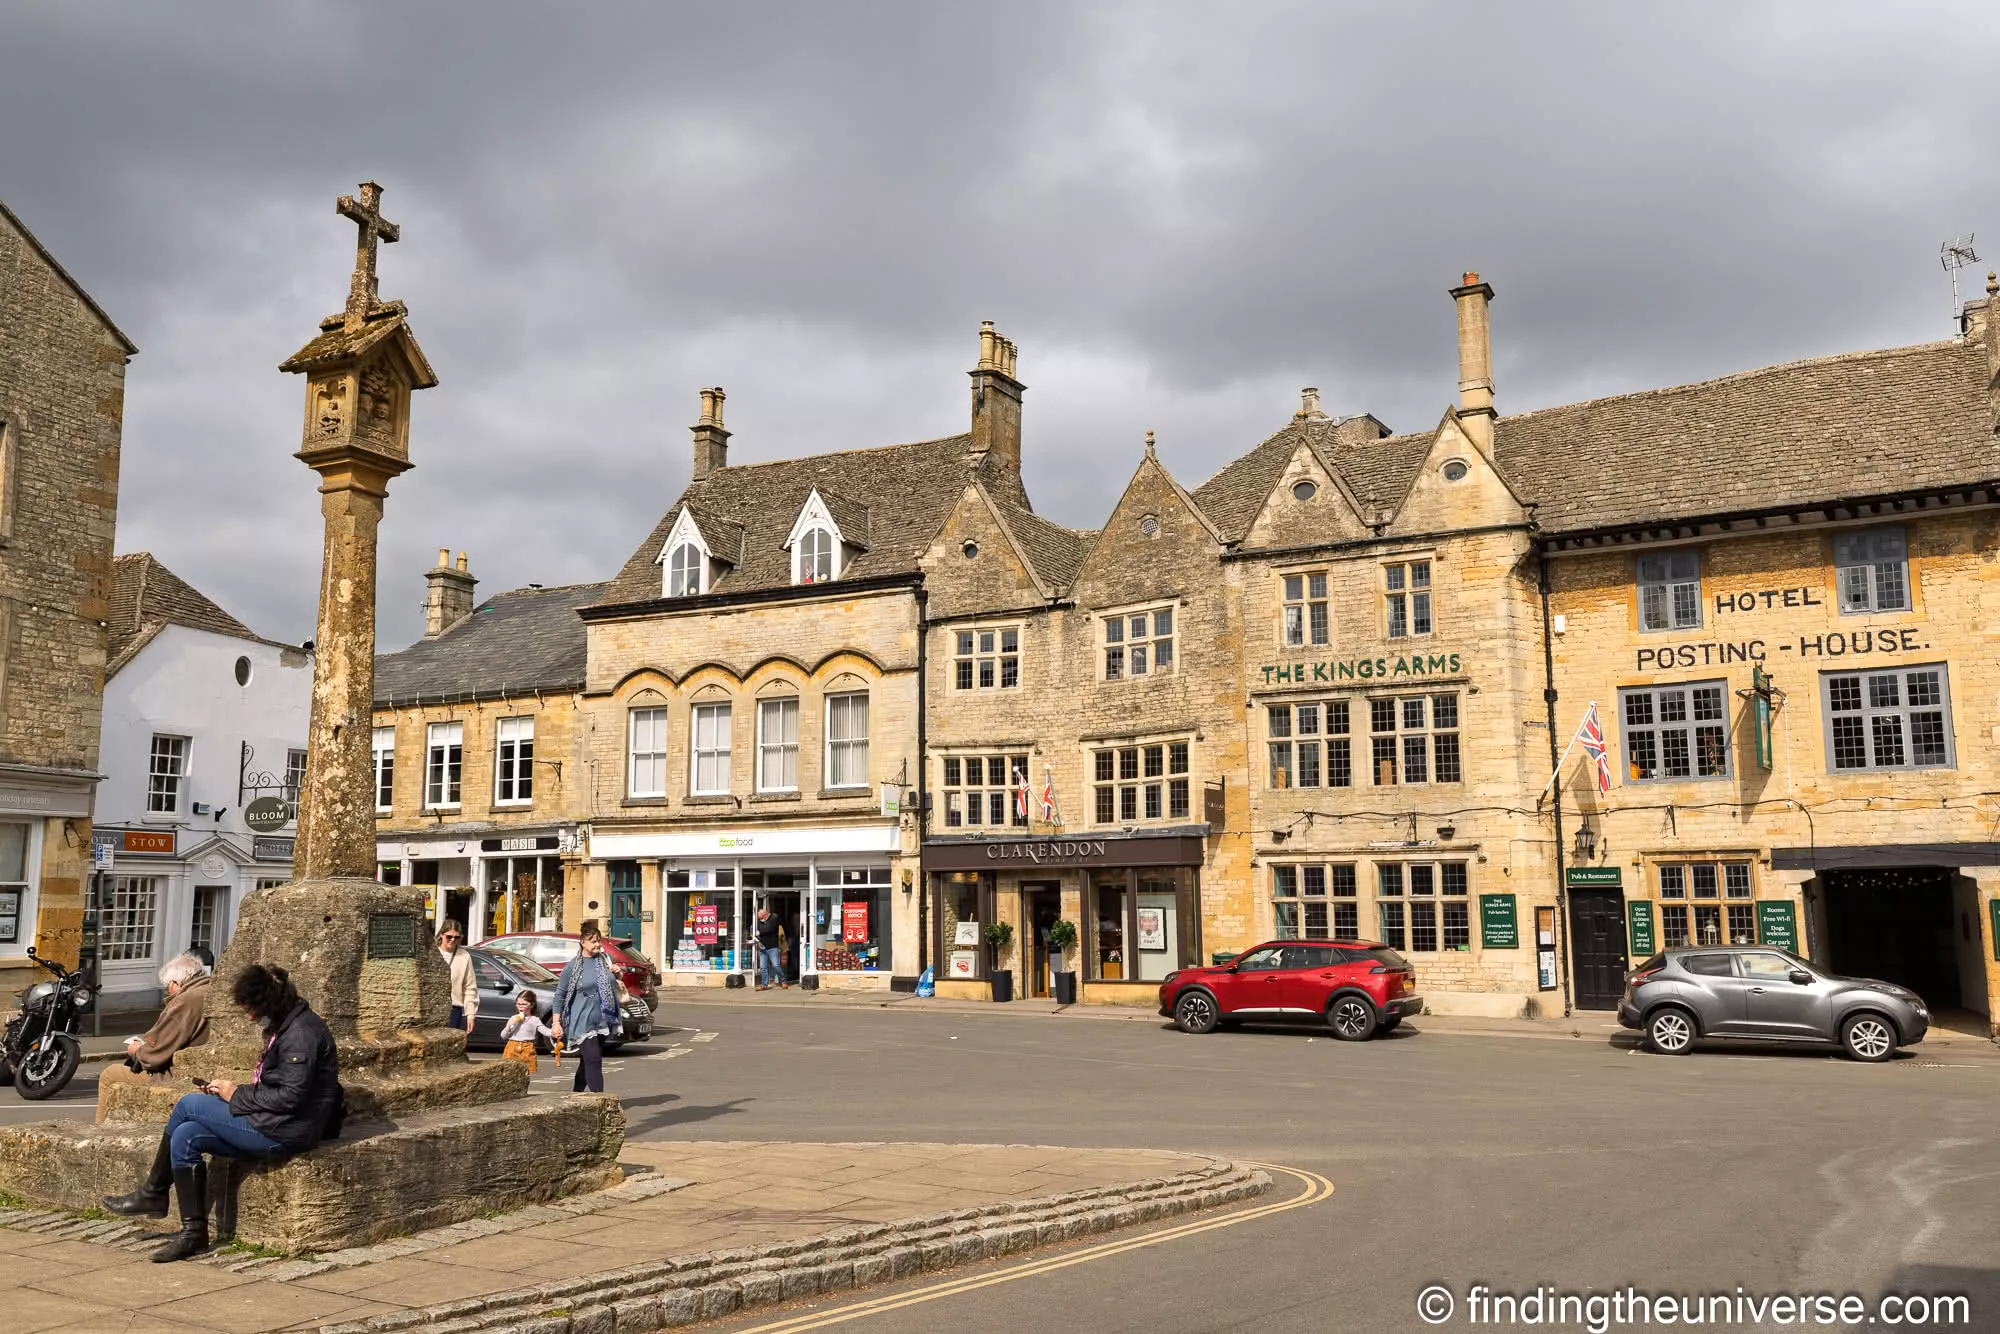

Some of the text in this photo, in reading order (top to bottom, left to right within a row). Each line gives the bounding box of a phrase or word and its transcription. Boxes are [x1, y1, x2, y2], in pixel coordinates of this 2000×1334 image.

[1715, 587, 1822, 614] HOTEL
[1637, 640, 1766, 671] POSTING
[1261, 653, 1461, 684] THE KINGS ARMS
[249, 811, 285, 821] BLOOM
[131, 837, 167, 847] STOW
[502, 839, 536, 850] MASH
[736, 837, 753, 847] food
[987, 841, 1106, 863] CLARENDON
